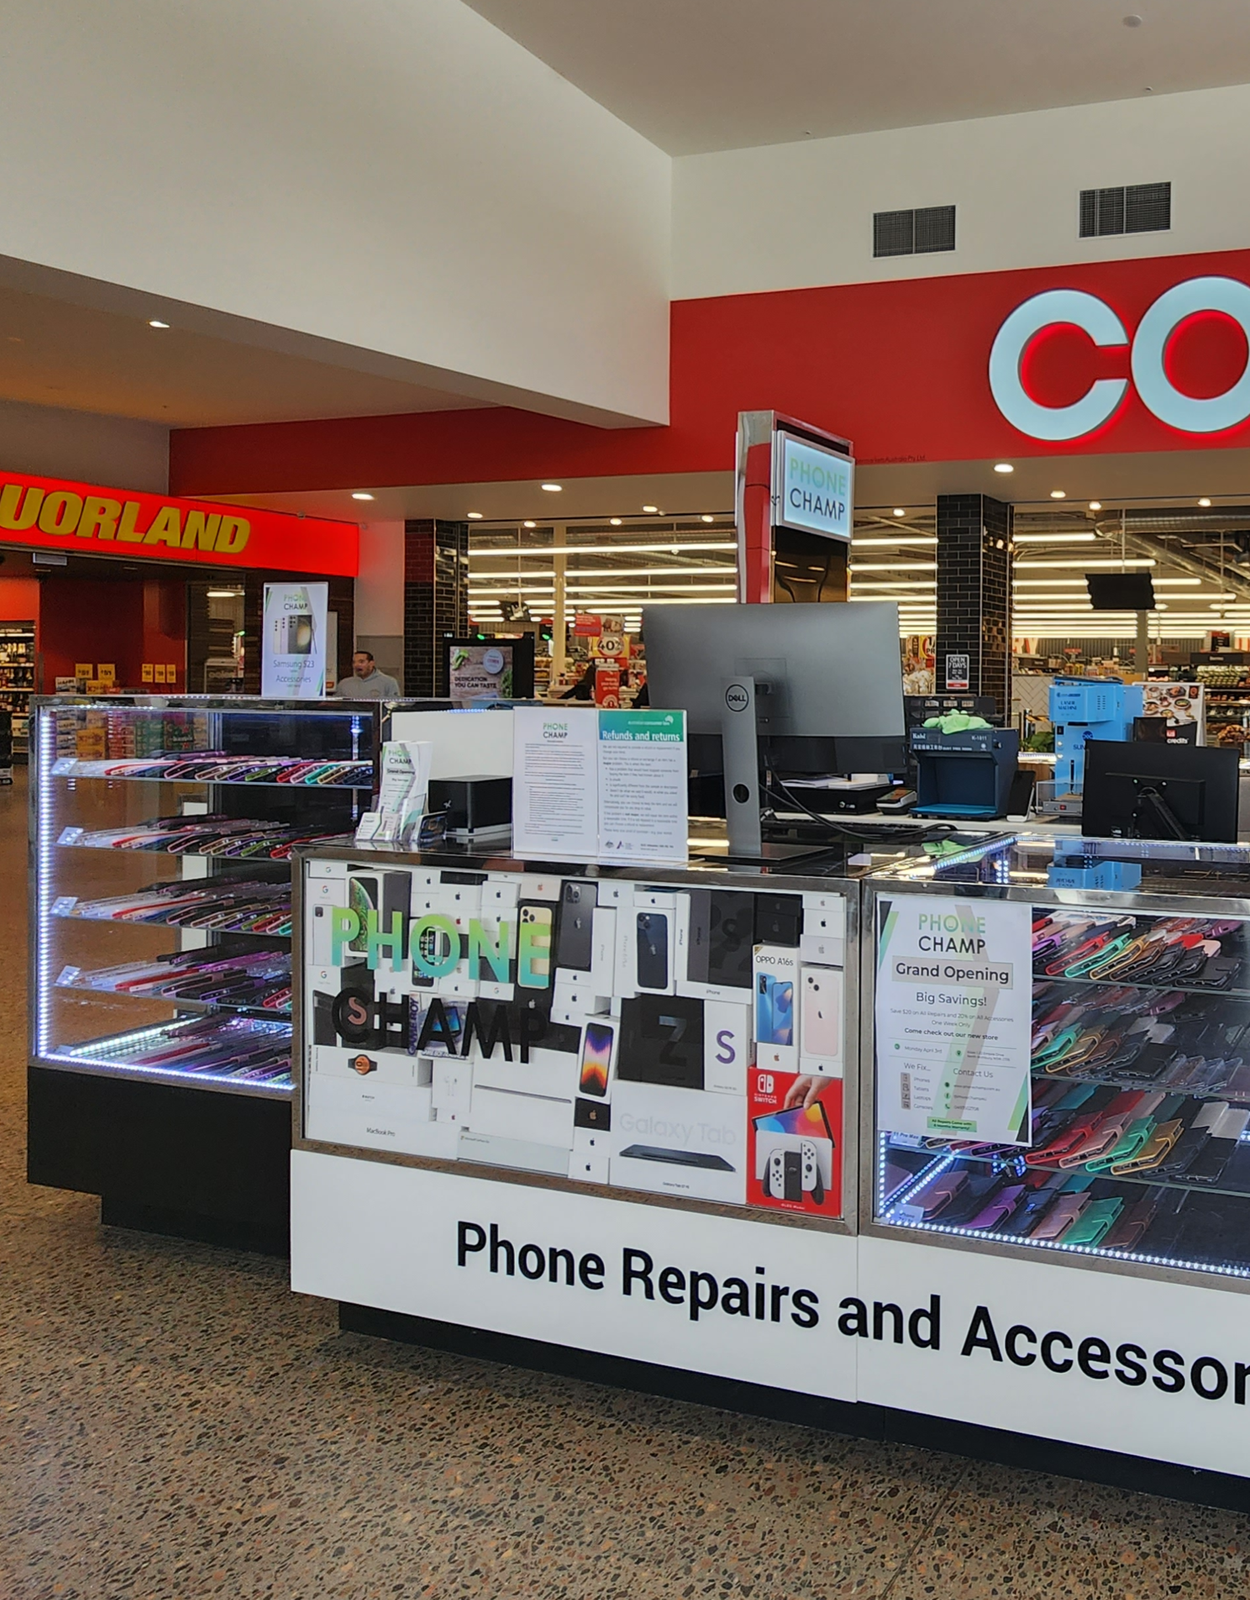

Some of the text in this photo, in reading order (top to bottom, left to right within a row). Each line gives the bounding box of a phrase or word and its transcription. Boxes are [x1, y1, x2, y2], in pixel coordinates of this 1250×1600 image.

[789, 456, 846, 497] PHONE
[789, 487, 846, 521] CHAMP
[273, 660, 302, 669] Samsung
[275, 675, 311, 684] Accessories
[727, 694, 747, 702] DELL
[542, 722, 568, 731] PHONE
[542, 731, 568, 739] CHAMP
[602, 729, 680, 742] Refunds and returns
[918, 913, 986, 934] PHONE
[331, 905, 551, 991] PHONE
[918, 935, 986, 955] CHAMP
[755, 955, 794, 967] OPPO A16s
[895, 962, 1010, 985] Grand Opening
[915, 991, 987, 1008] Big Savings!
[984, 1014, 1014, 1023] Accessories
[331, 987, 549, 1066] CHAMP
[904, 1027, 922, 1035] Come
[923, 1028, 942, 1036] check
[981, 1033, 999, 1041] store
[714, 1029, 737, 1065] S
[952, 1067, 994, 1079] Contact Us
[753, 1096, 777, 1105] SWITCH
[366, 1127, 396, 1137] MacBook Pro
[618, 1111, 738, 1147] Galaxy Tab
[458, 1220, 605, 1291] Phone
[622, 1247, 819, 1330] Repairs
[837, 1298, 941, 1351] and
